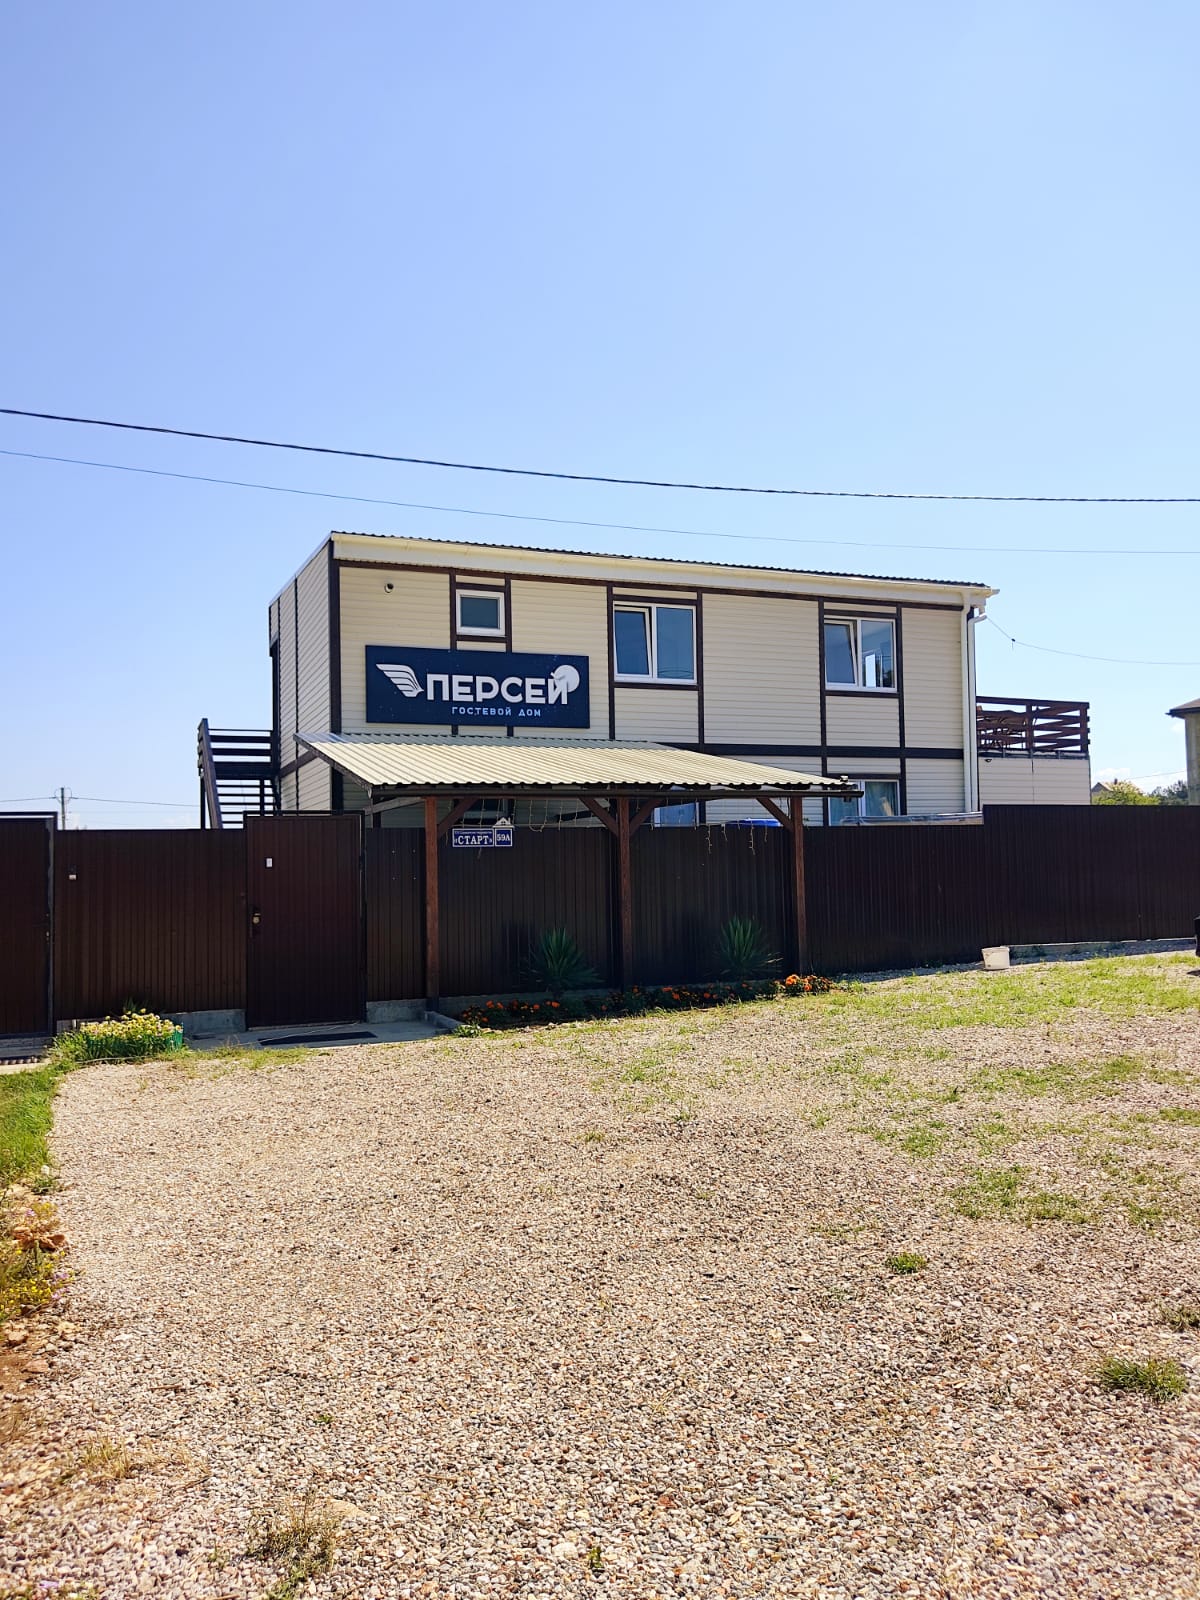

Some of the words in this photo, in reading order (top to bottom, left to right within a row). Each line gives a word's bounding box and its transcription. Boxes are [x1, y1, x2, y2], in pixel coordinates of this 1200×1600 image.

[426, 672, 568, 705] ПЕРСЕЙ
[451, 706, 512, 717] ГОСТЕВОЙ
[518, 708, 542, 718] ДОМ
